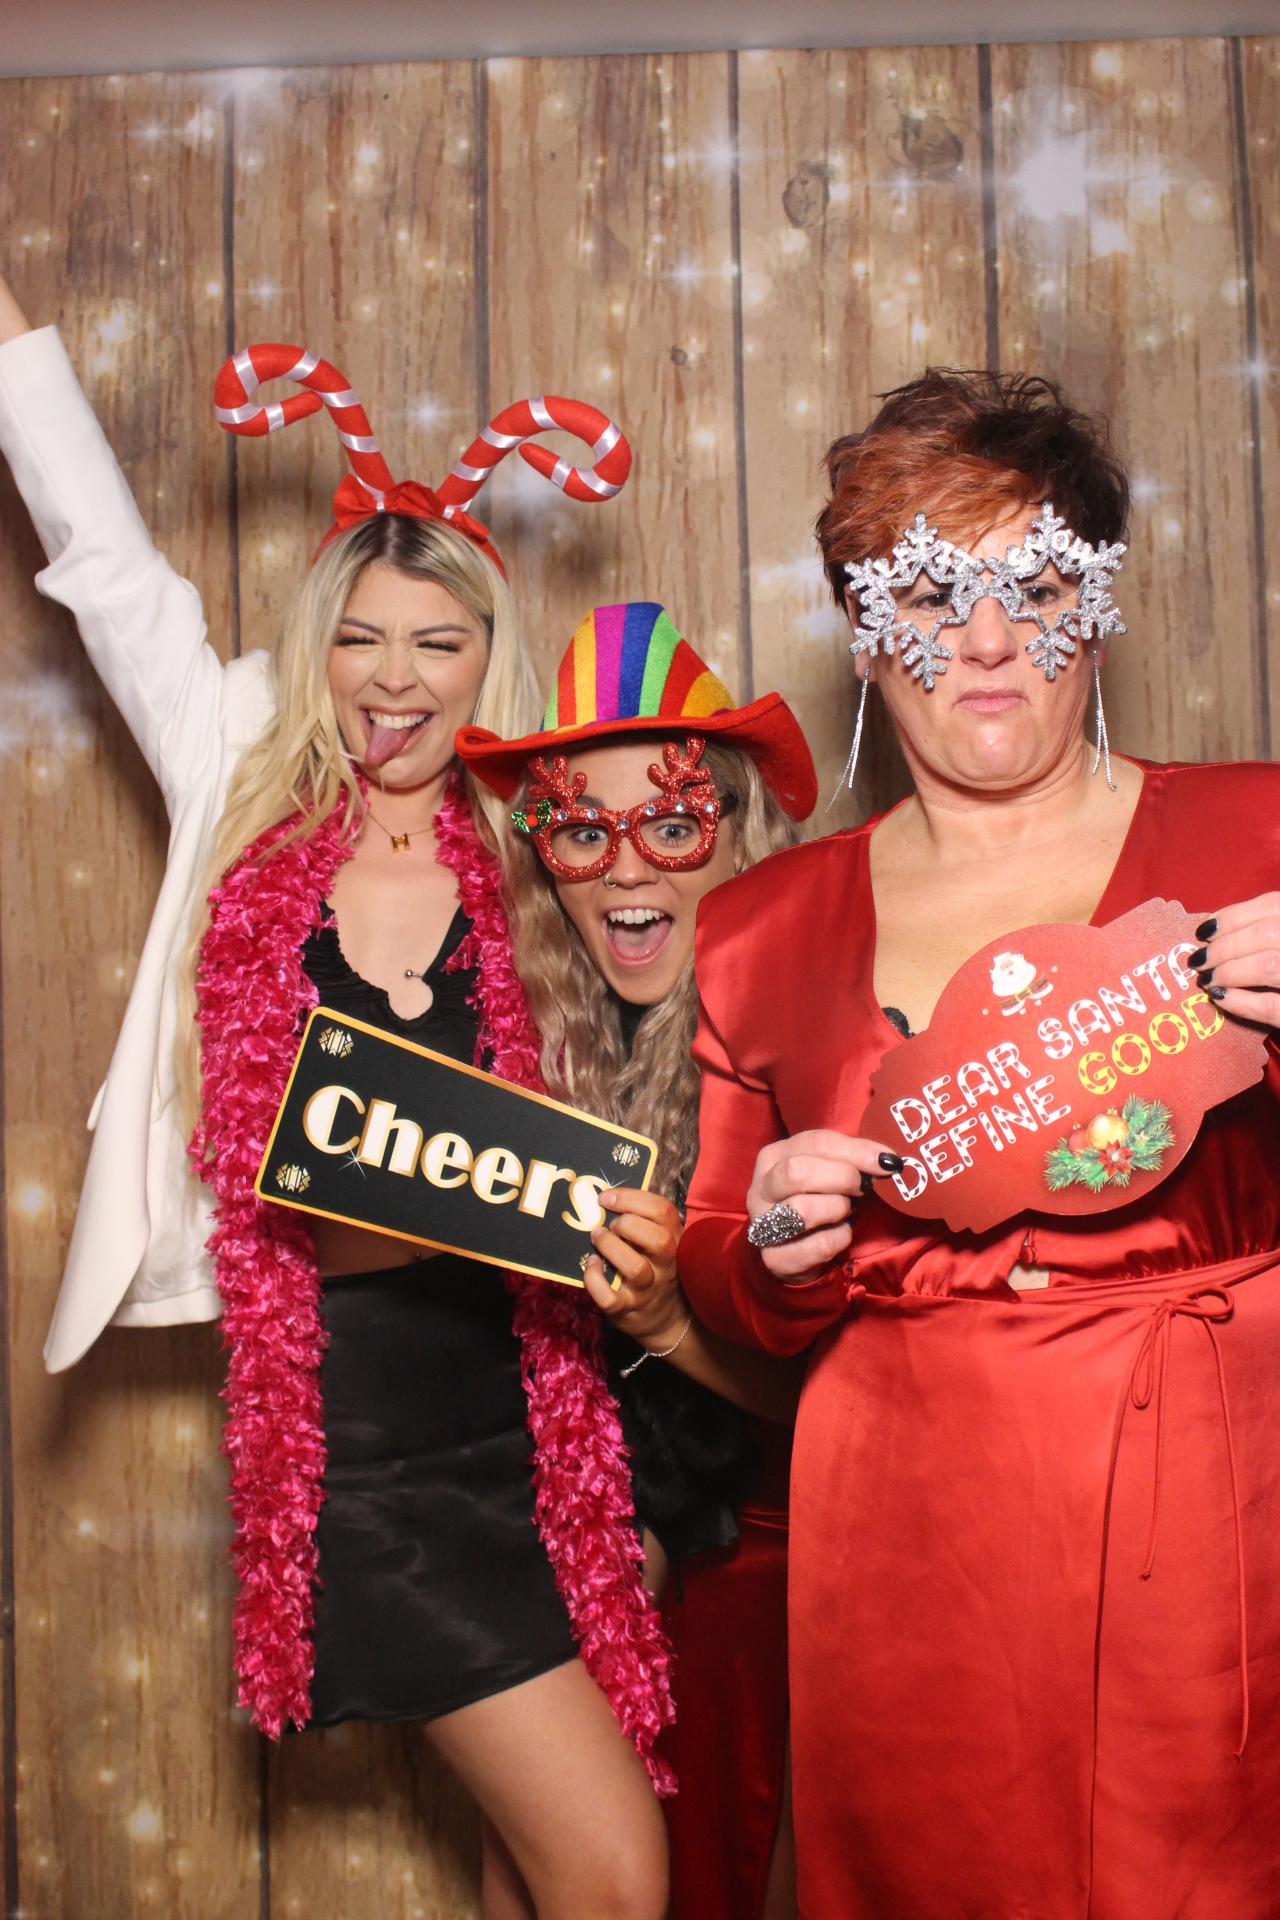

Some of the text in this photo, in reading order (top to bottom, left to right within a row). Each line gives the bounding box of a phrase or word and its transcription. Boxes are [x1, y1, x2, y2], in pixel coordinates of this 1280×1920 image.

[302, 1085, 613, 1232] Cheers
[890, 1042, 1031, 1143] DEAR
[892, 993, 1224, 1201] DEFINE GOOD
